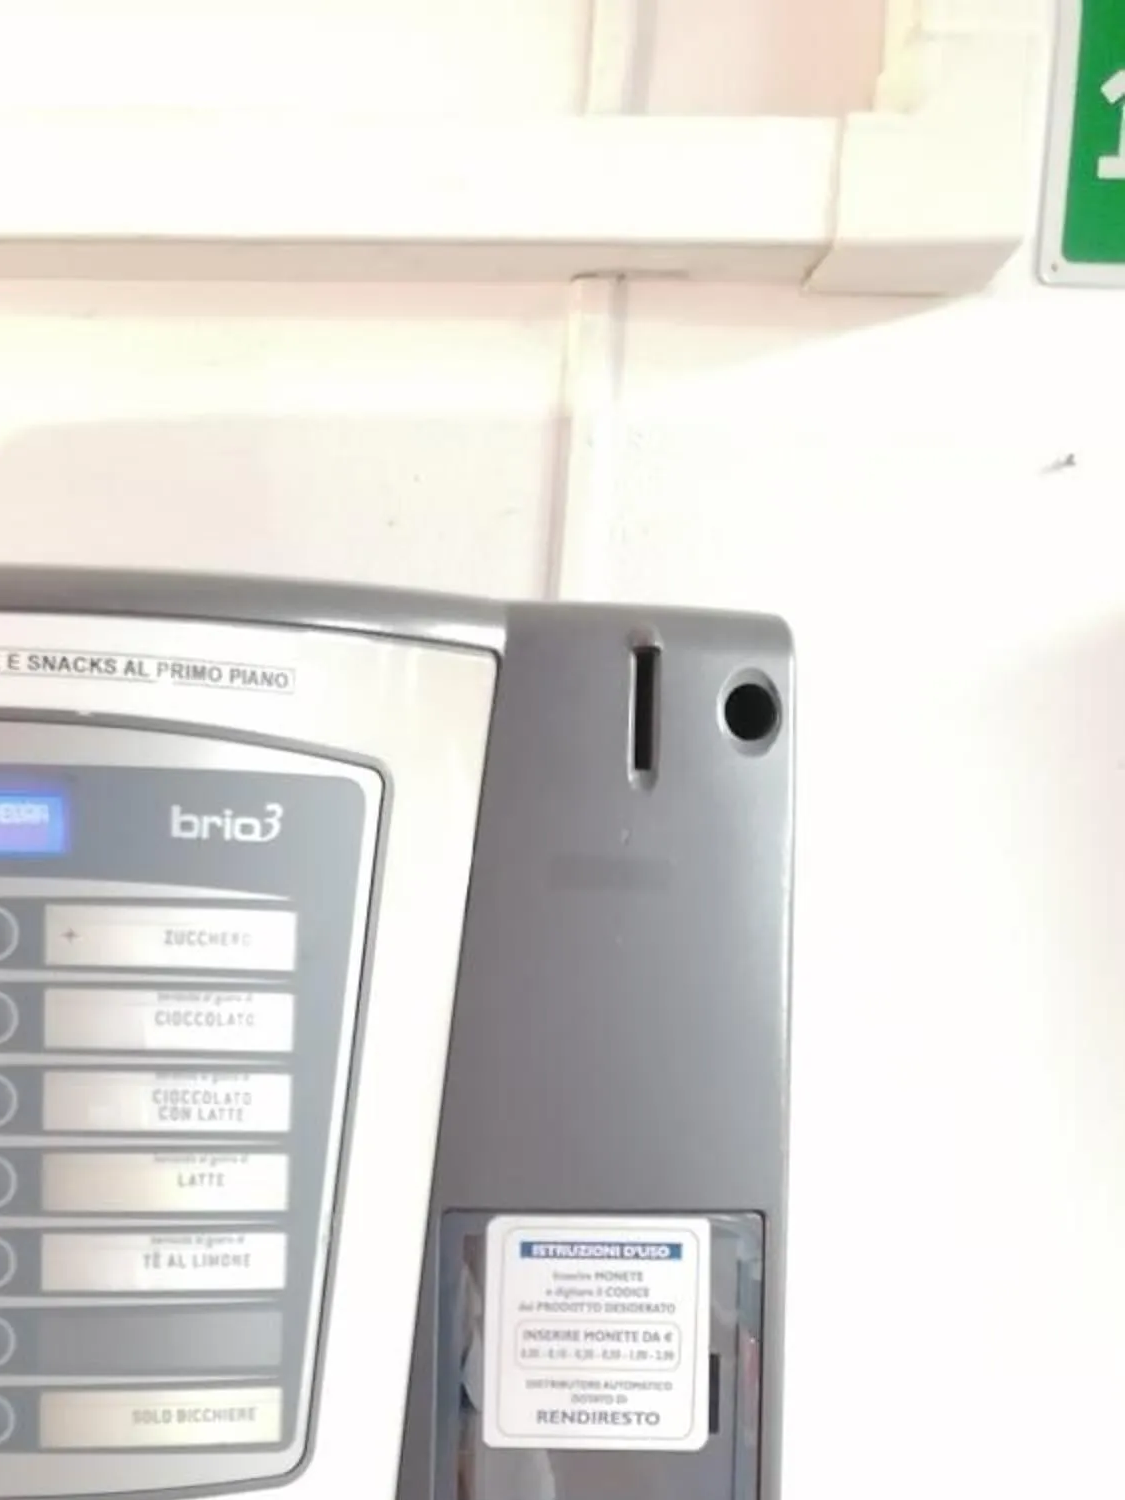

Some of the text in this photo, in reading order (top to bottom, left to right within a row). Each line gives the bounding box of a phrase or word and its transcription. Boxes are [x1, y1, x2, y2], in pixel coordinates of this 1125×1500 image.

[7, 653, 20, 671] E
[27, 655, 116, 676] SNACKS
[124, 659, 150, 678] AL
[156, 661, 222, 683] PRIMO
[229, 668, 289, 689] PIANO
[164, 929, 252, 947] ZUCCHERO
[154, 1010, 255, 1028] CIOCCOLATO
[152, 1089, 253, 1106] CIOCCOLATO
[158, 1106, 245, 1122] CON LATTE
[177, 1172, 226, 1188] LATTE
[531, 1244, 621, 1258] ISTRUZIONI
[167, 1254, 186, 1269] AL
[192, 1253, 251, 1268] LIMONE
[594, 1271, 644, 1282] MONETE
[605, 1286, 650, 1298] CODICE
[536, 1302, 602, 1313] PRODOTTO
[604, 1302, 676, 1315] DESIDERATO
[523, 1329, 581, 1342] INSERIRE
[583, 1330, 640, 1343] MONETE
[642, 1331, 661, 1343] DA
[131, 1406, 257, 1425] SOLO BICCHIERE
[536, 1410, 660, 1426] RENDIRESTO
